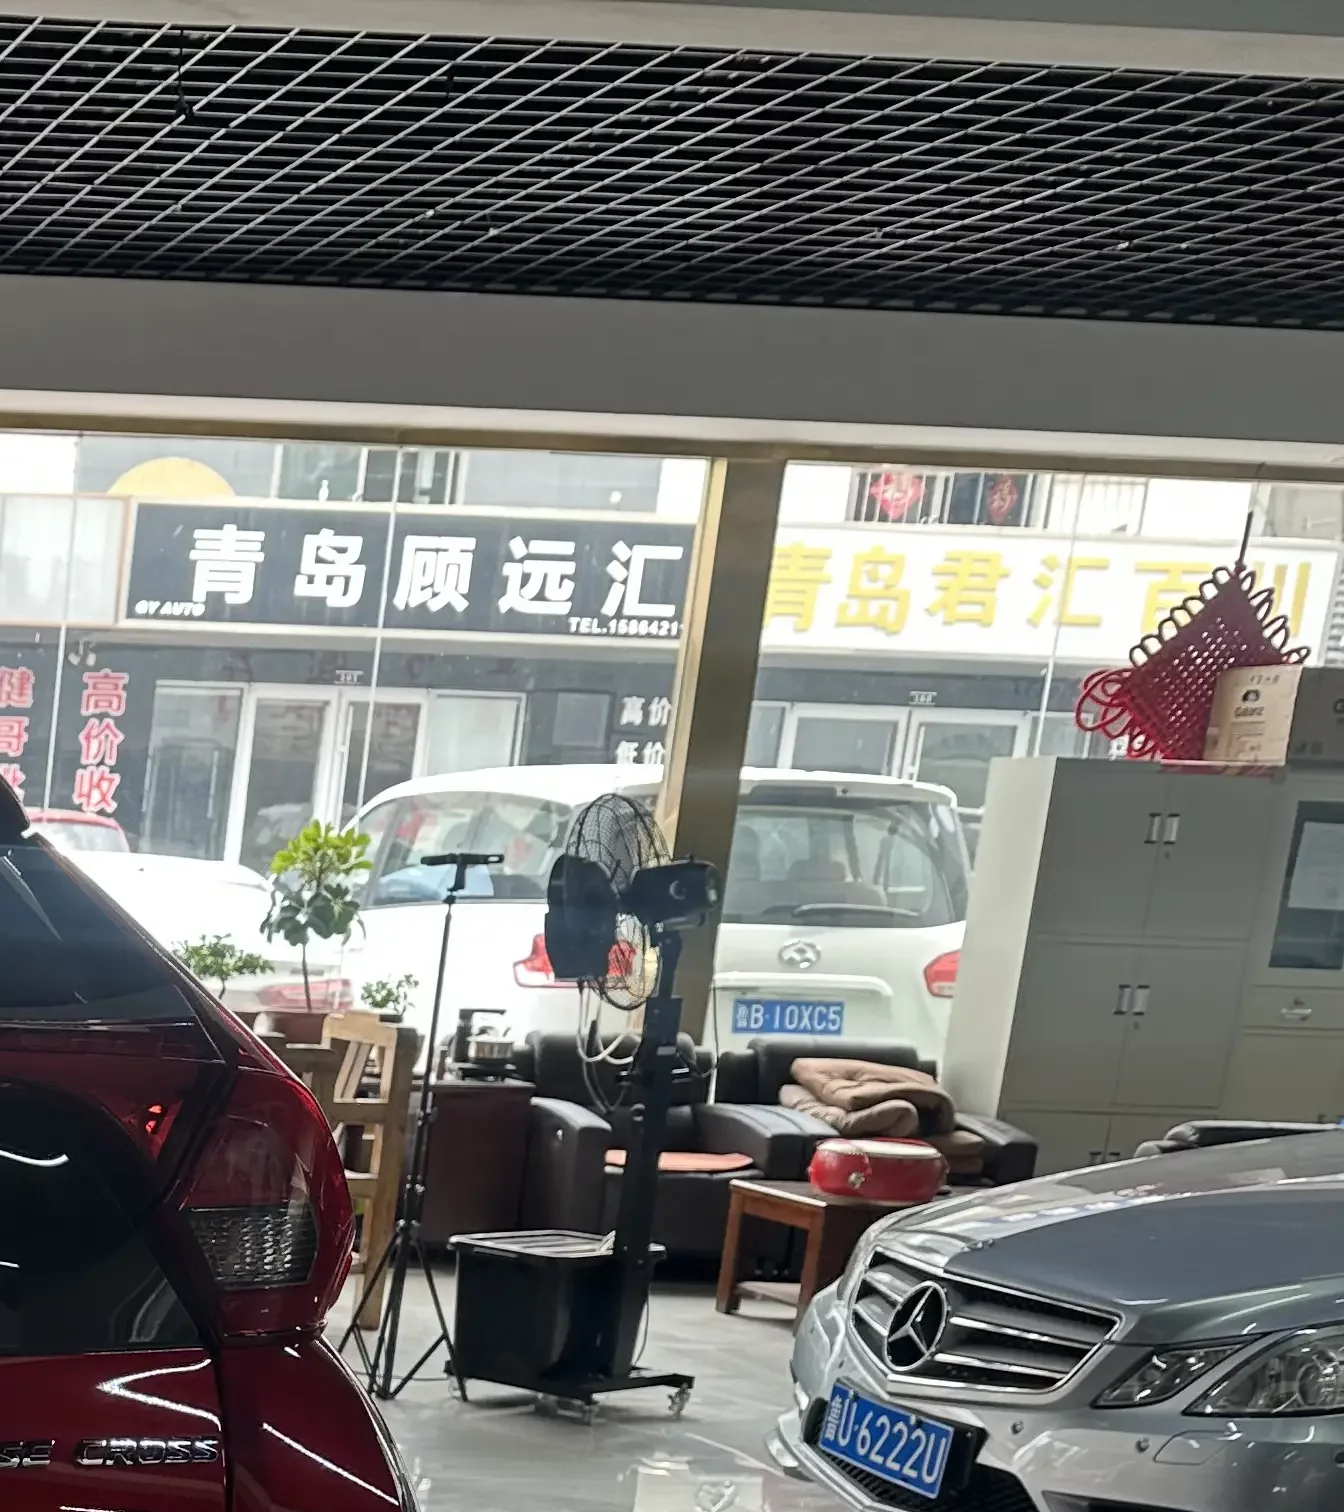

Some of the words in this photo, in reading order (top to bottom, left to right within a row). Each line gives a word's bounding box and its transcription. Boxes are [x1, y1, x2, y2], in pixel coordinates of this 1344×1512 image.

[186, 523, 684, 617] 青岛顾远汇
[568, 616, 684, 636] TEL.1586421
[72, 667, 130, 813] 高价收
[73, 1435, 221, 1468] CROSS
